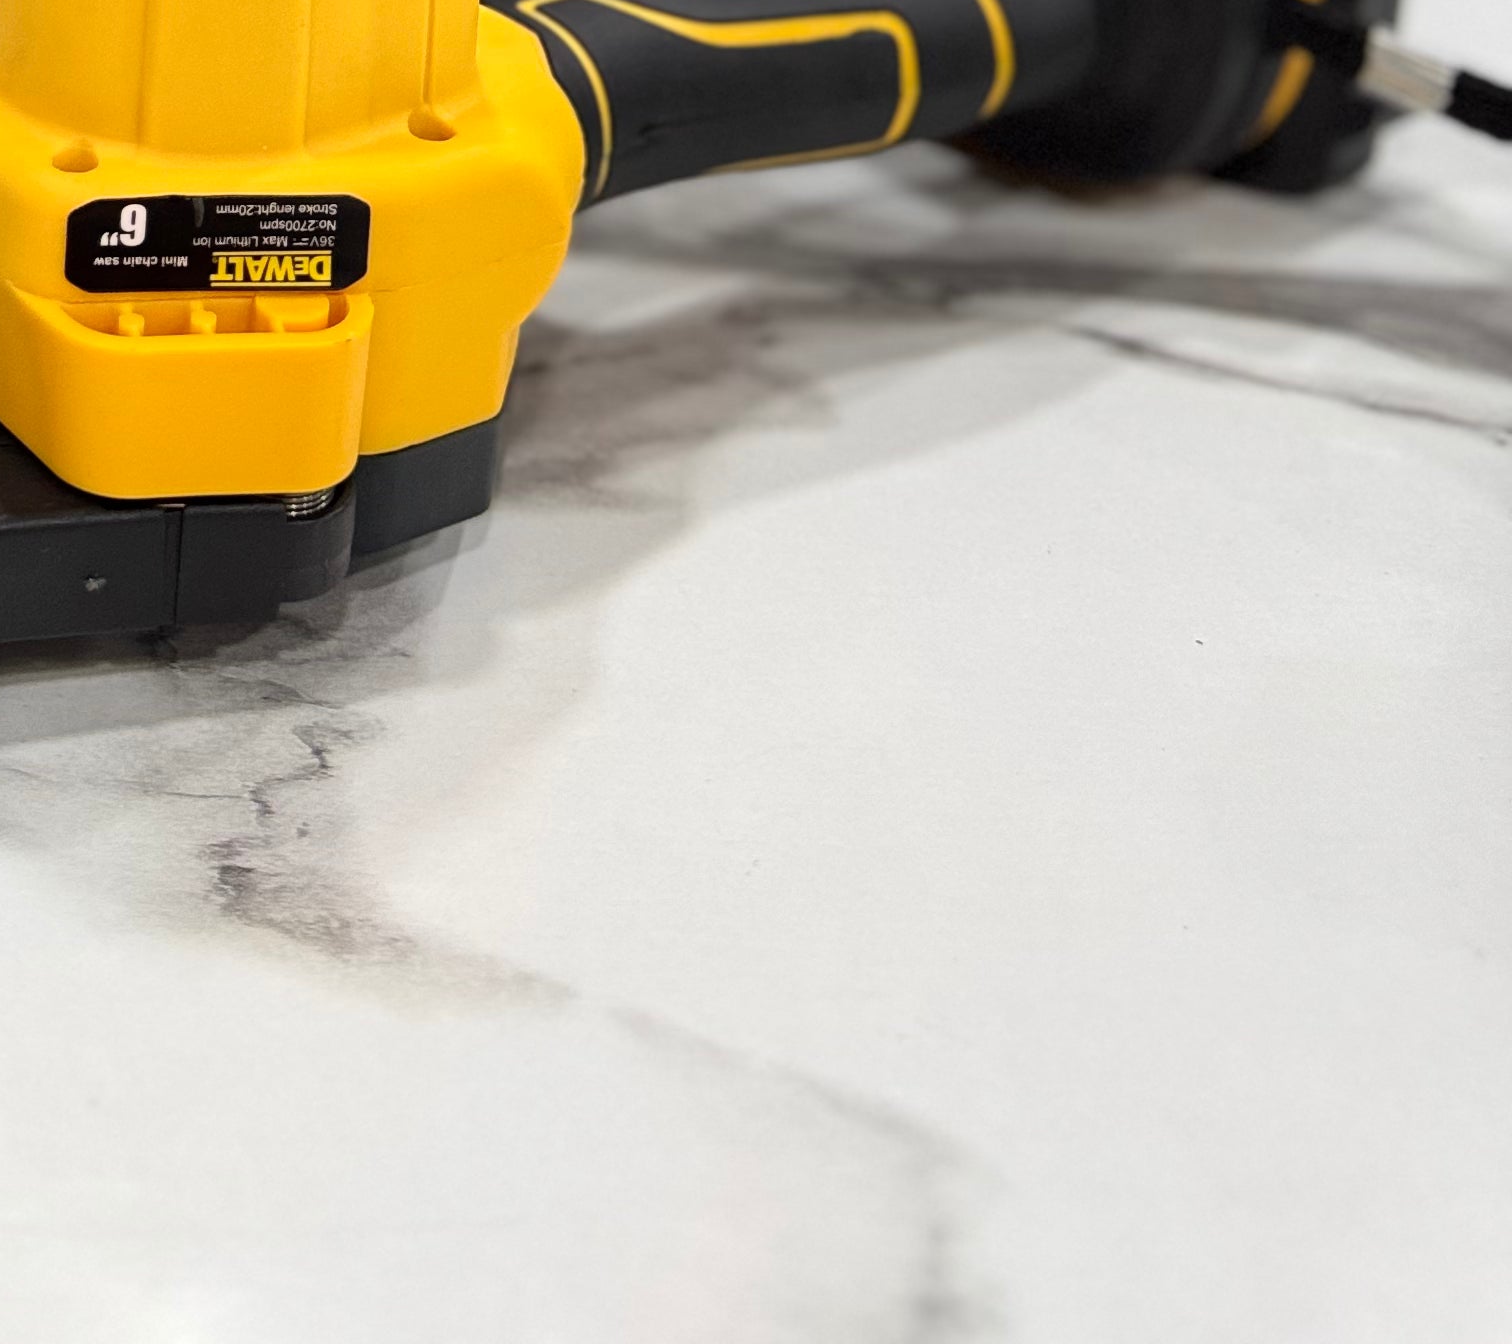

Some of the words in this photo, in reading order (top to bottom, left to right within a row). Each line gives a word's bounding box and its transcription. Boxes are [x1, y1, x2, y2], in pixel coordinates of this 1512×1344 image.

[298, 203, 338, 216] Stroke
[193, 236, 211, 248] Ion
[215, 236, 259, 248] Lithium
[262, 236, 288, 248] Max
[93, 256, 120, 266] saw
[123, 256, 158, 267] chain
[161, 256, 188, 267] Mini
[209, 255, 332, 282] DEWALT
